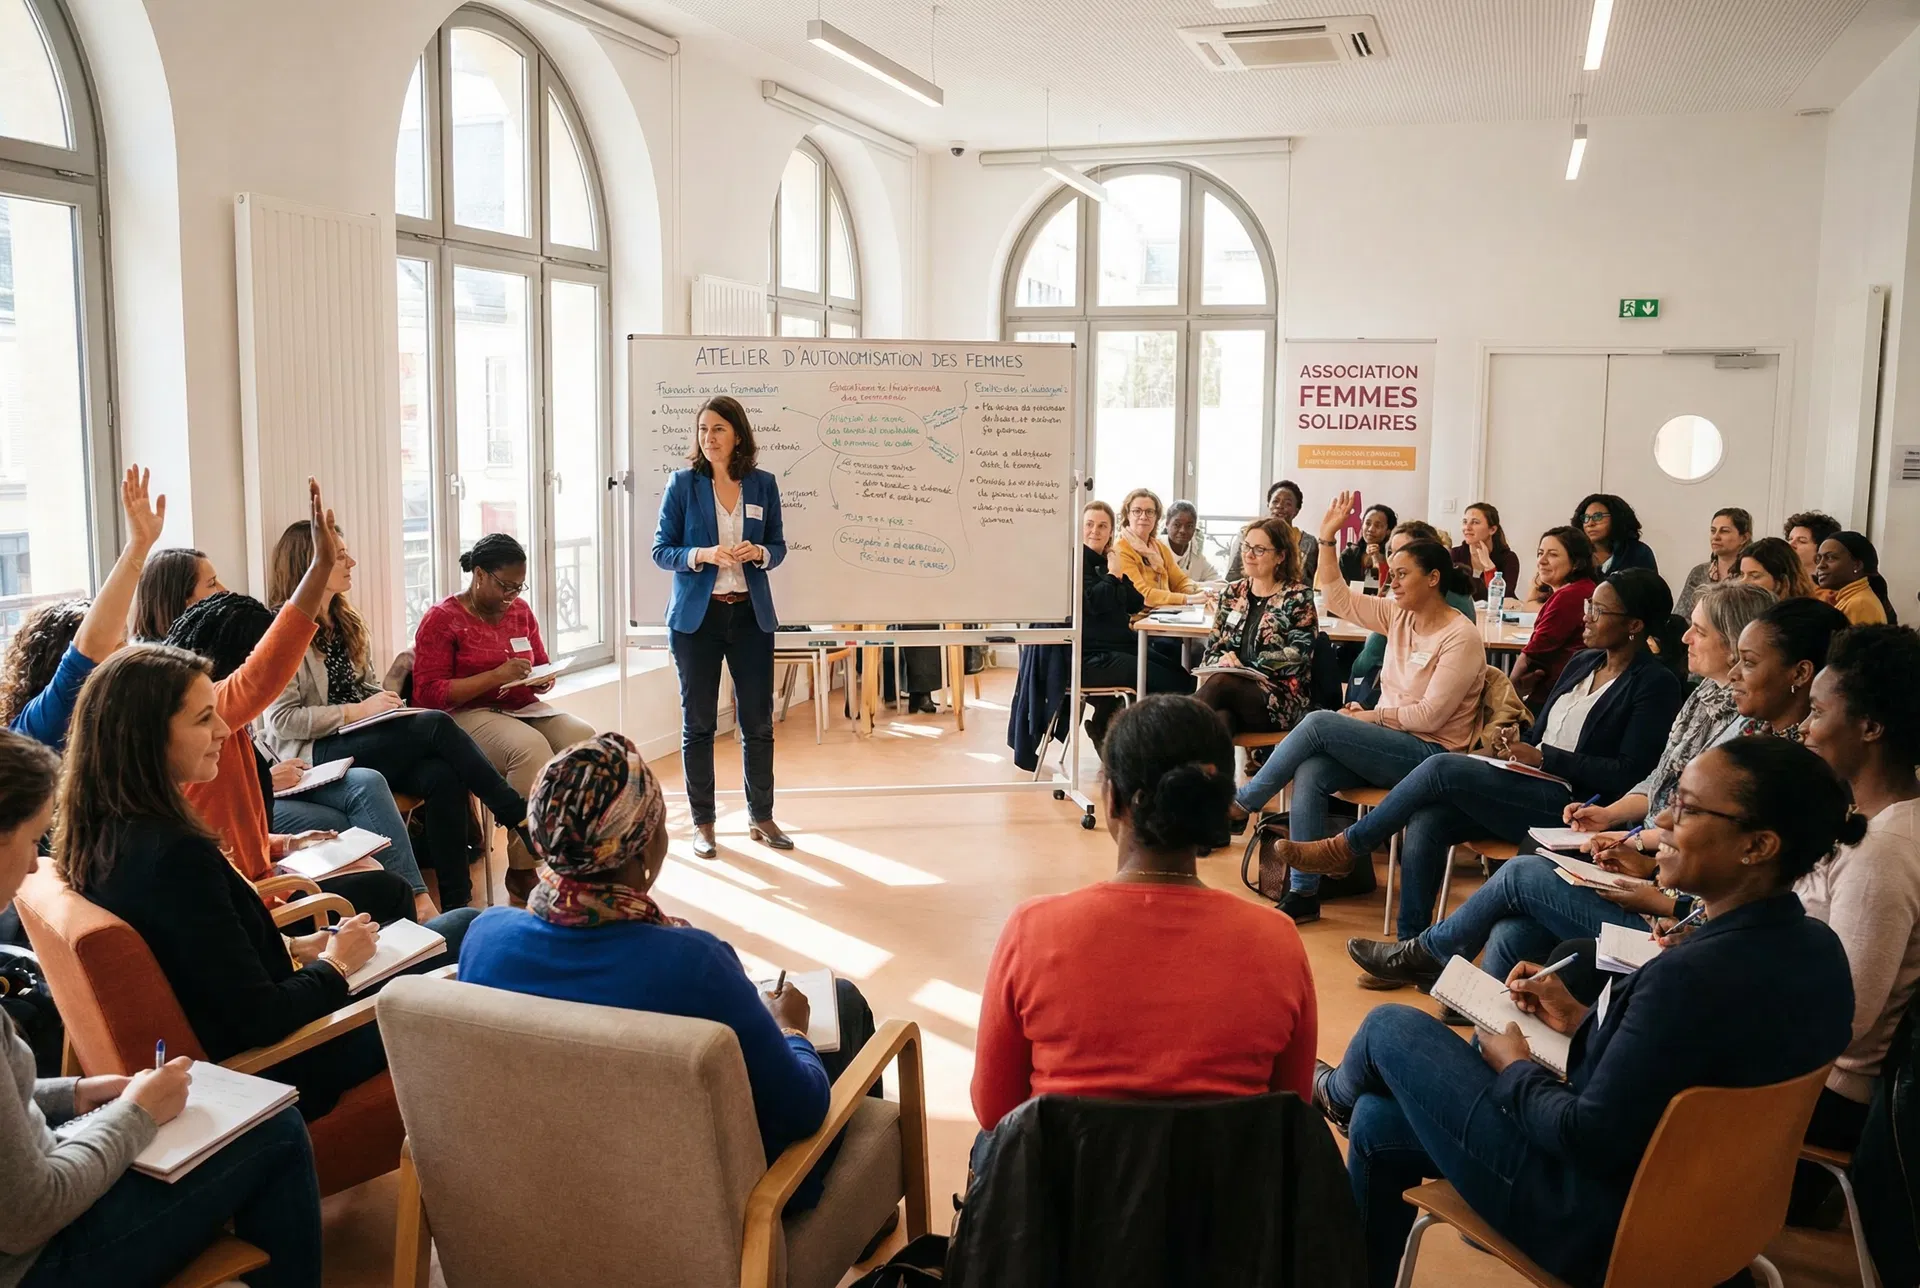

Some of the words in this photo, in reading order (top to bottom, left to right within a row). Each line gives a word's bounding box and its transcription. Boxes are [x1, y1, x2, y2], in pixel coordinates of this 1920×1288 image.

[932, 352, 958, 368] DES
[966, 353, 1024, 369] FEMMES
[1300, 365, 1418, 379] ASSOCIATION
[1299, 385, 1418, 408] FEMMES
[1298, 413, 1417, 431] SOLIDAIRES
